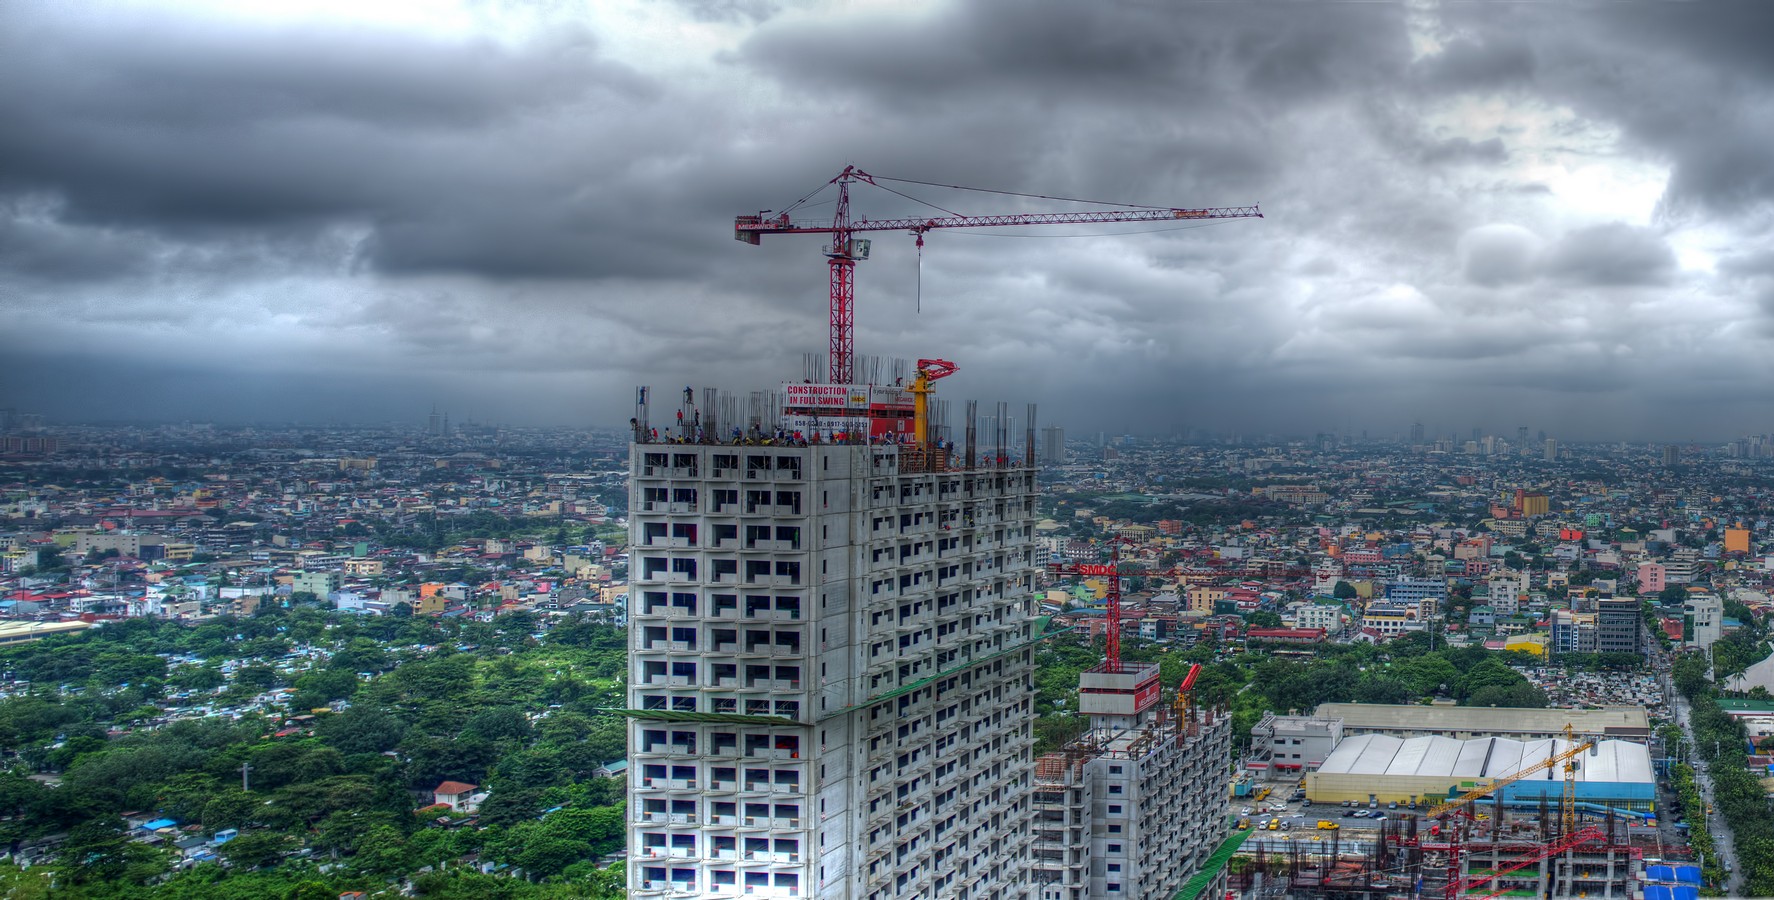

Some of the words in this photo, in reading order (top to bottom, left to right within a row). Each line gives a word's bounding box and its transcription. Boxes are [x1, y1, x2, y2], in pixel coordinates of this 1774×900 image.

[787, 385, 847, 395] CONSTRUCTION
[789, 396, 798, 404] IN
[799, 396, 817, 405] FULL
[818, 397, 844, 406] SWING
[1079, 563, 1117, 576] SMDC
